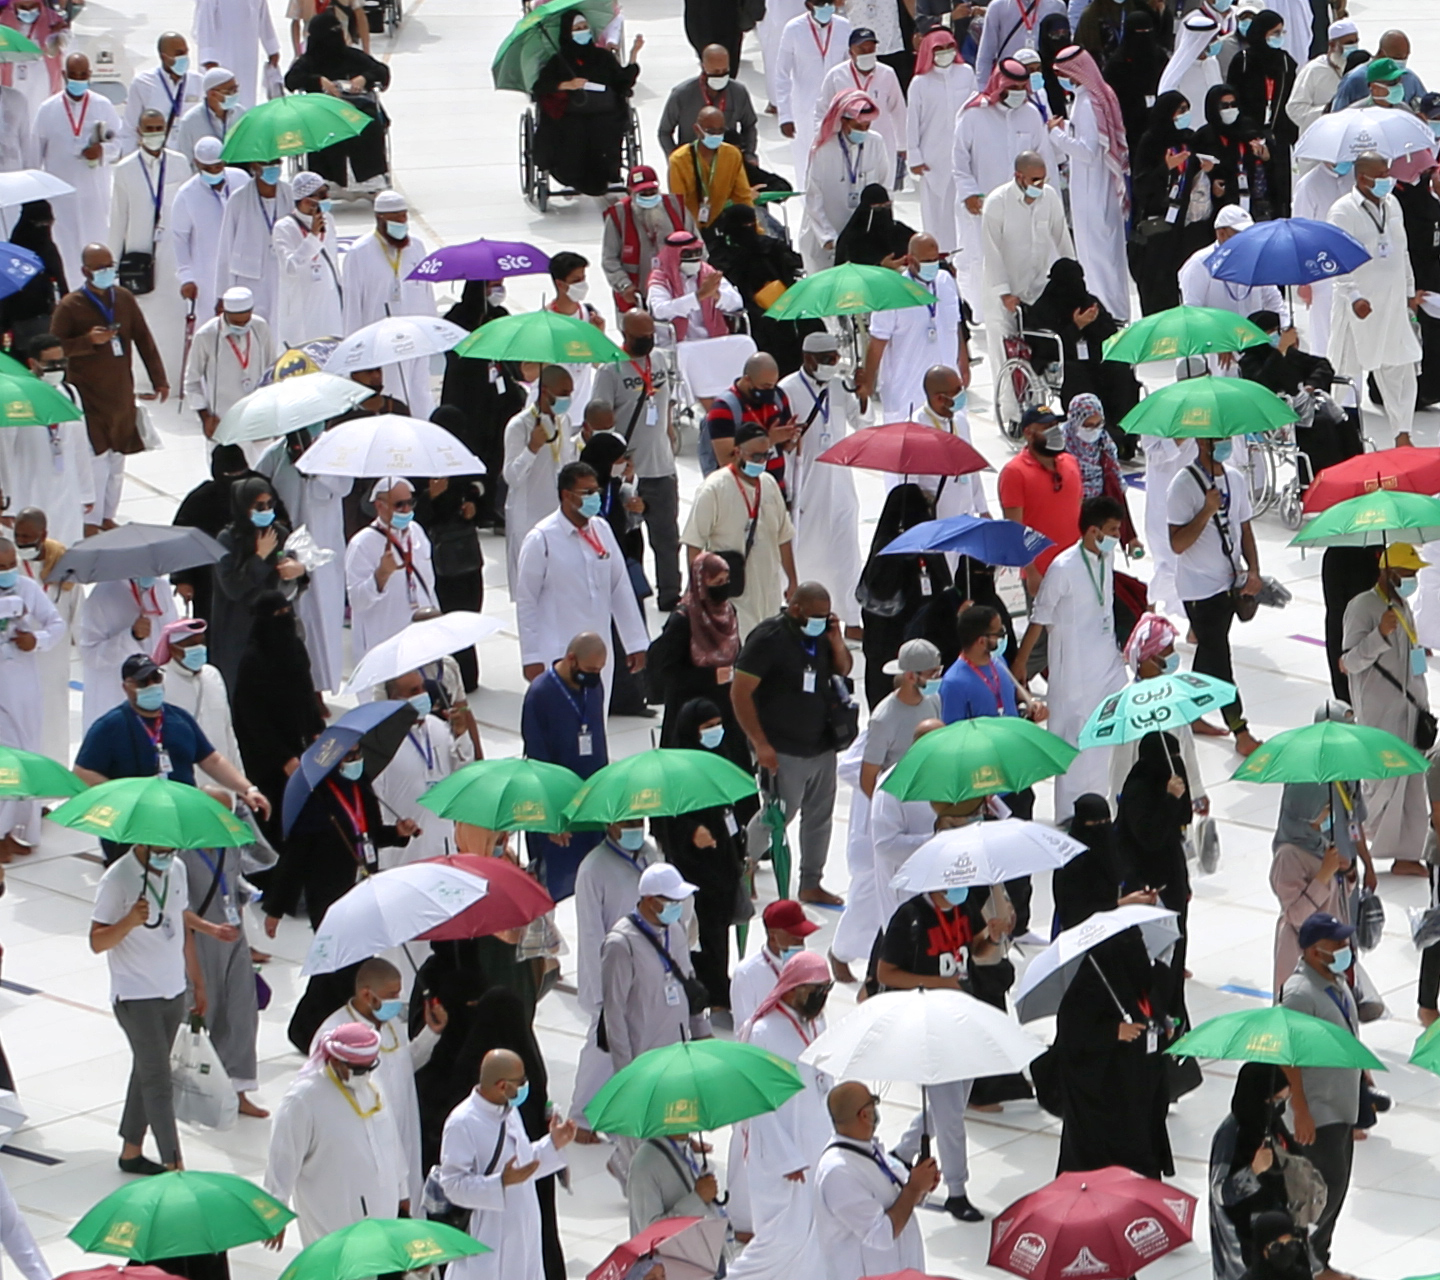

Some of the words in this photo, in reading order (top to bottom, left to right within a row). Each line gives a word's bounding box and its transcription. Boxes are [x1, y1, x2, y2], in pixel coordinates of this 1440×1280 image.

[418, 257, 443, 275] stc
[498, 253, 532, 271] stc
[1131, 683, 1174, 705] زين
